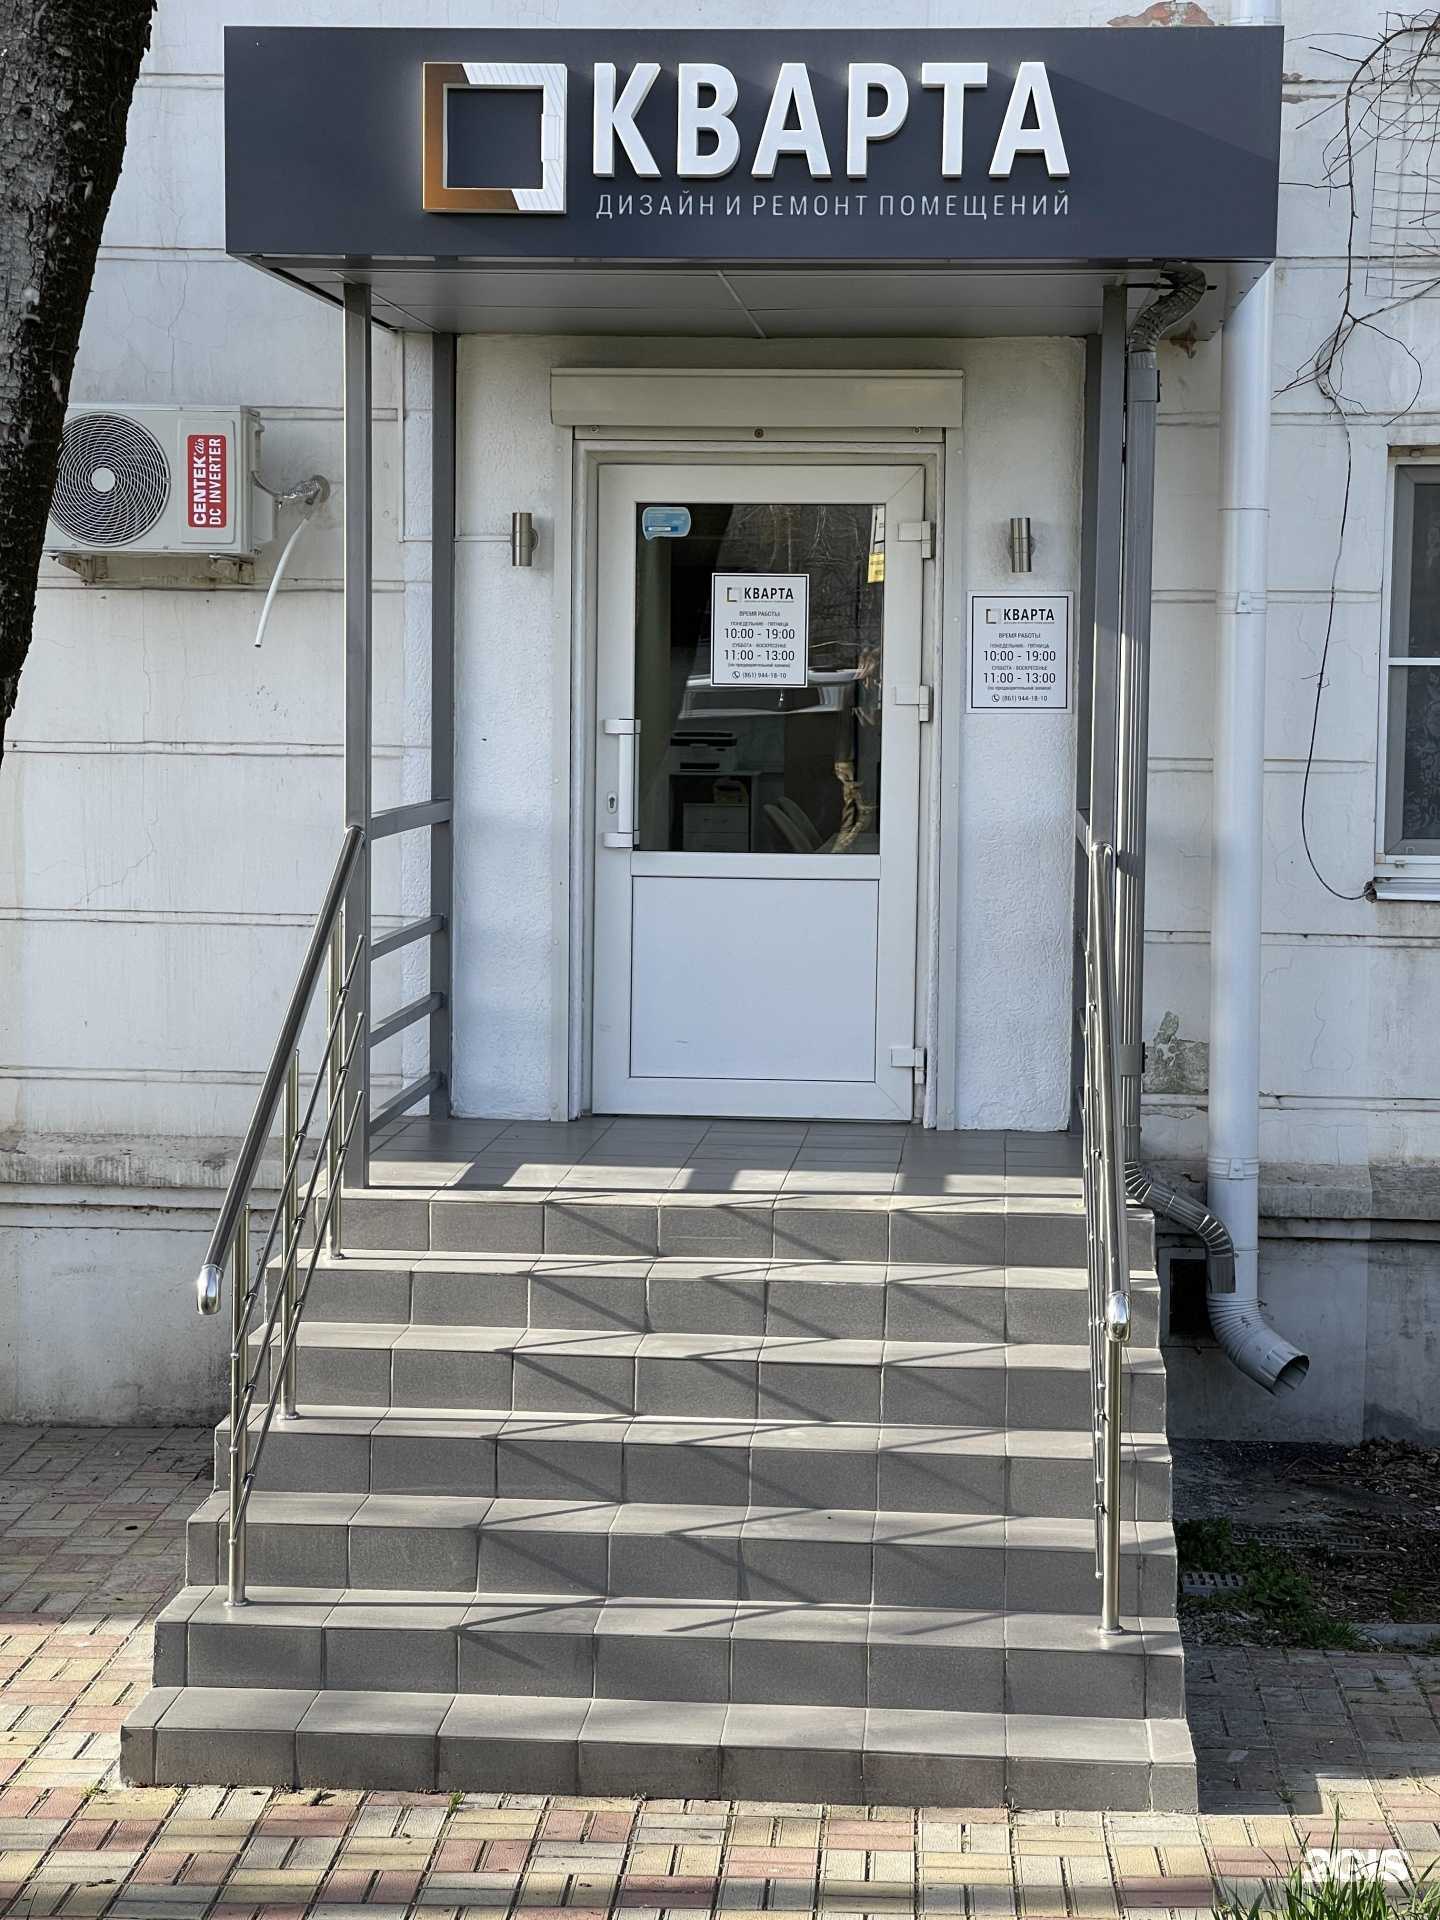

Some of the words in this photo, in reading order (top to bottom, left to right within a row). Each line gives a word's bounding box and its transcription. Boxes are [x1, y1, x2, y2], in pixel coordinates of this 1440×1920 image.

[593, 61, 1071, 179] КВАРТА
[596, 189, 714, 219] ДИЗАЙН
[726, 195, 741, 216] И
[752, 194, 868, 216] РЕМОНТ
[879, 188, 1069, 220] ПОМЕЩЕНИЙ
[208, 438, 221, 503] INVERTER
[193, 455, 207, 525] CENTEK
[208, 508, 221, 525] DC
[744, 587, 794, 600] КВАРТА
[1003, 608, 1055, 621] КВАРТА
[724, 628, 754, 639] 10:00
[765, 628, 795, 640] 19:00
[724, 649, 754, 661] 11:00
[765, 650, 795, 661] 13:00
[983, 650, 1014, 662] 10:00
[1026, 650, 1056, 662] 19:00
[983, 672, 1014, 683] 11:00
[1026, 672, 1056, 684] 13:00
